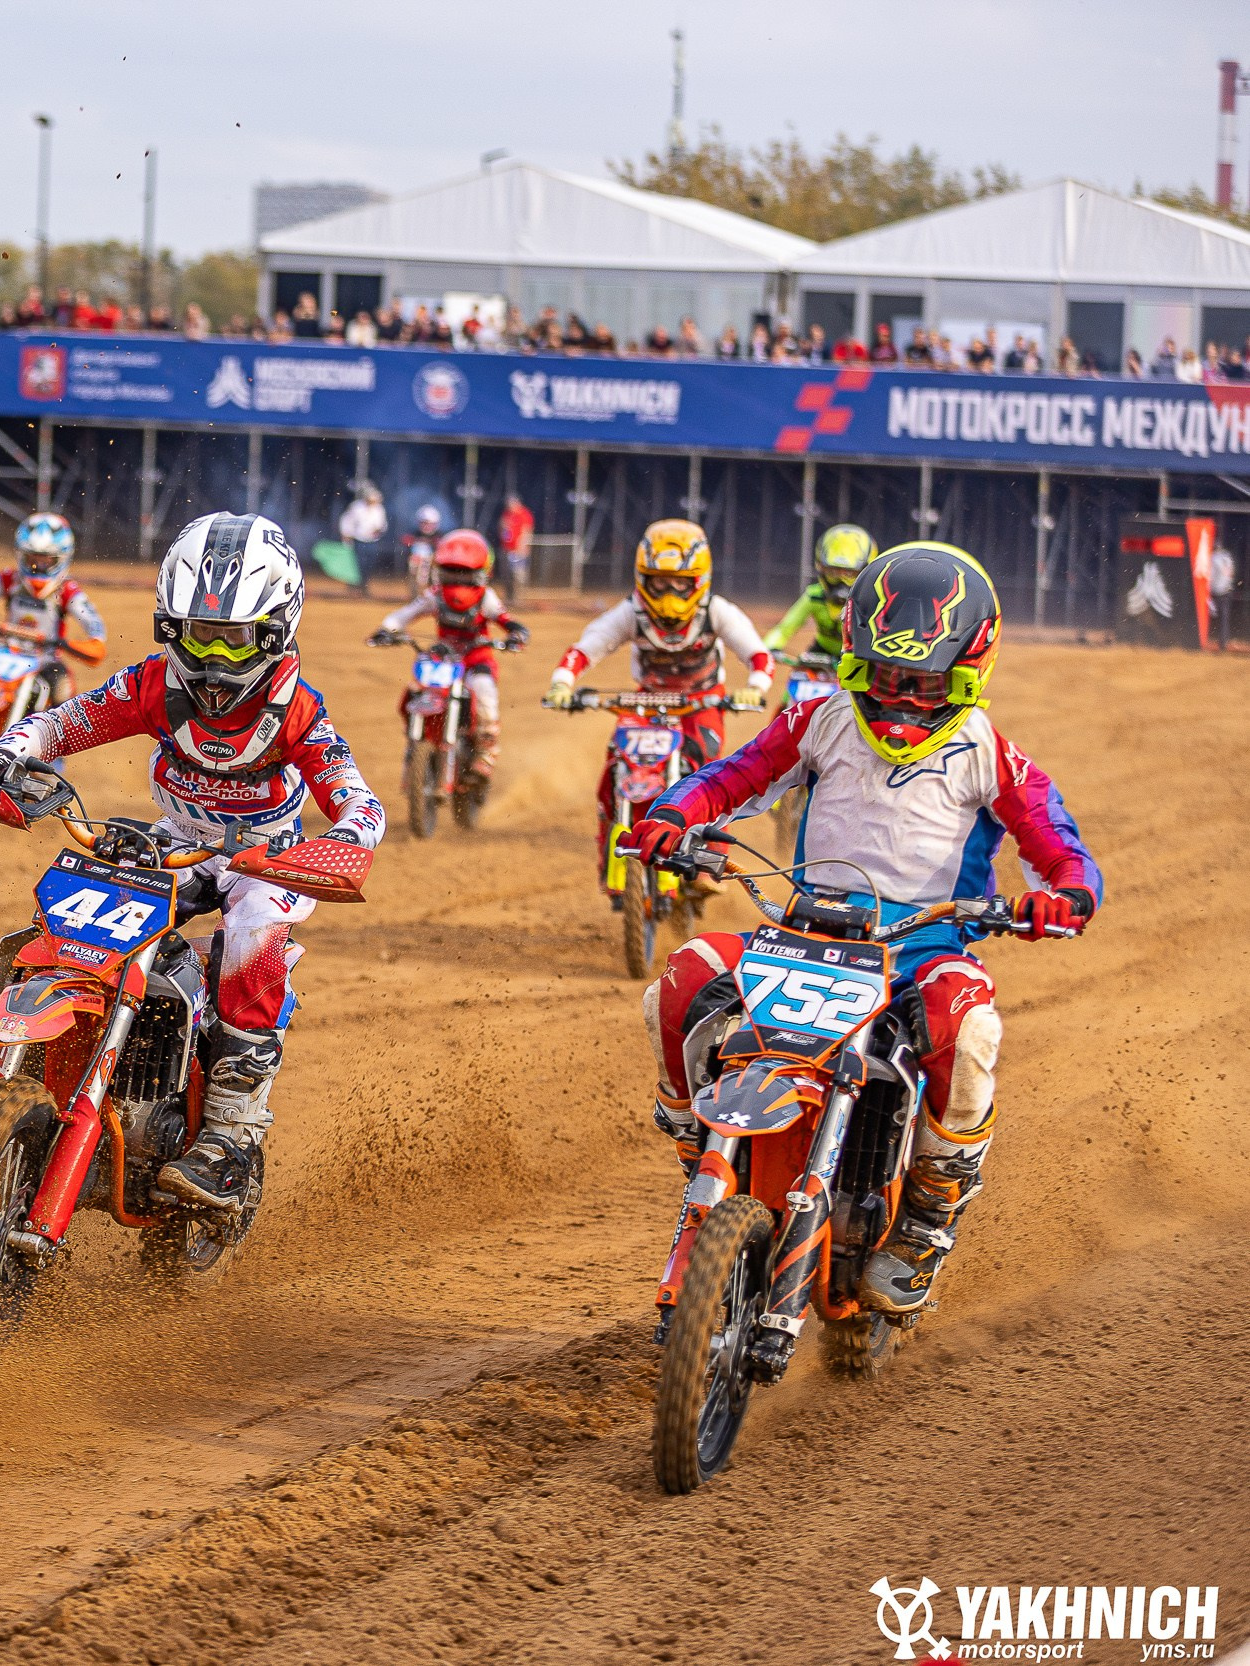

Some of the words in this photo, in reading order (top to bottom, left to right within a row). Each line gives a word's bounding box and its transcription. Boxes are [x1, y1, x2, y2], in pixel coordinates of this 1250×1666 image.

[888, 387, 1097, 448] МОТОКРОСС
[872, 628, 930, 661] 6D
[201, 743, 233, 756] ORTEMA
[261, 867, 334, 885] ACERBIS
[46, 887, 157, 942] 44
[62, 943, 108, 960] MILYAEV
[75, 953, 100, 964] SCHOOL
[751, 938, 807, 959] VOYTENKO
[740, 961, 880, 1035] 752
